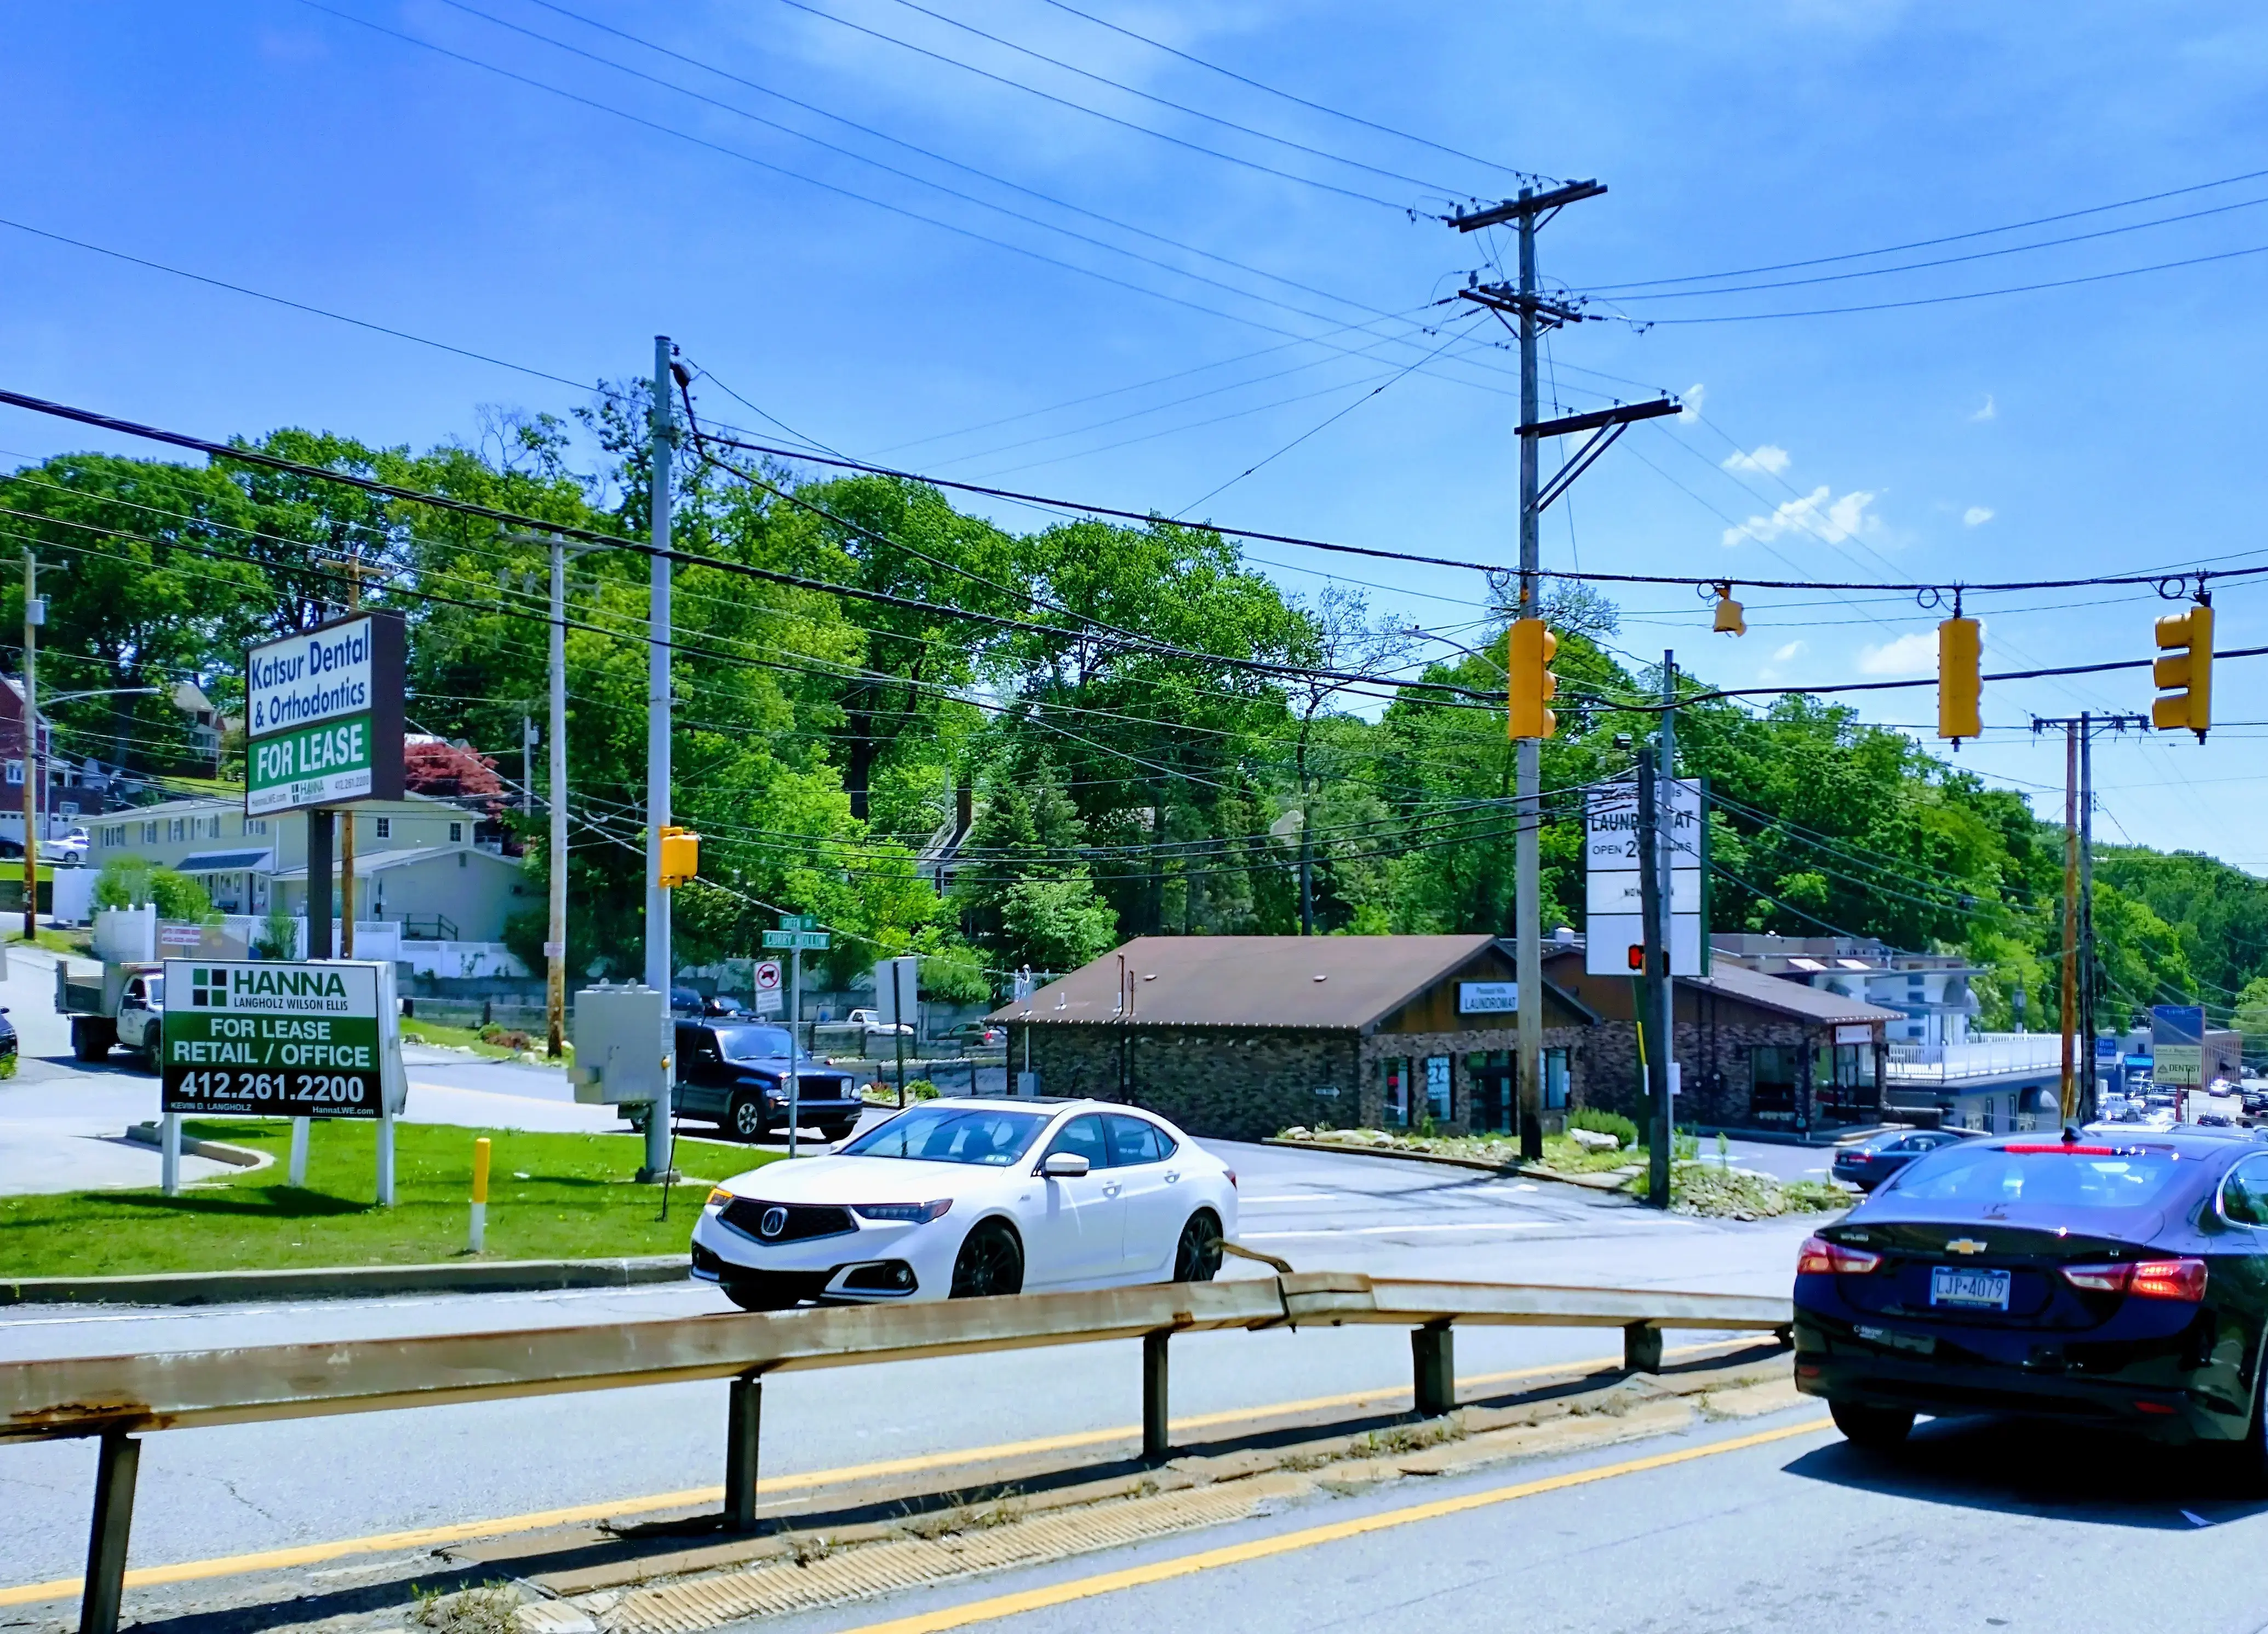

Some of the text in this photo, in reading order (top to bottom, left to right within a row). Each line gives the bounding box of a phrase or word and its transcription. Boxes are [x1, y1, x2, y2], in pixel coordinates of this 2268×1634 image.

[251, 624, 369, 691] Katsur Dental
[255, 677, 365, 728] & Orthodontics
[257, 723, 364, 782] FOR LEASE
[1591, 810, 1693, 832] LAUNDAT
[1592, 845, 1622, 855] OPEN
[766, 933, 793, 945] CURRY
[234, 969, 347, 997] HANNA
[234, 997, 348, 1011] LANGHOLZ WILSON ELLIS
[210, 1018, 331, 1041] FOR LEASE
[173, 1041, 370, 1067] RETAIL / OFFICE
[1428, 1067, 1450, 1084] 24
[2169, 1064, 2200, 1072] DENTIST
[180, 1071, 364, 1102] 412.261.2200
[207, 1103, 252, 1111] LANGHOLZ
[312, 1106, 374, 1115] HannaLWE.com
